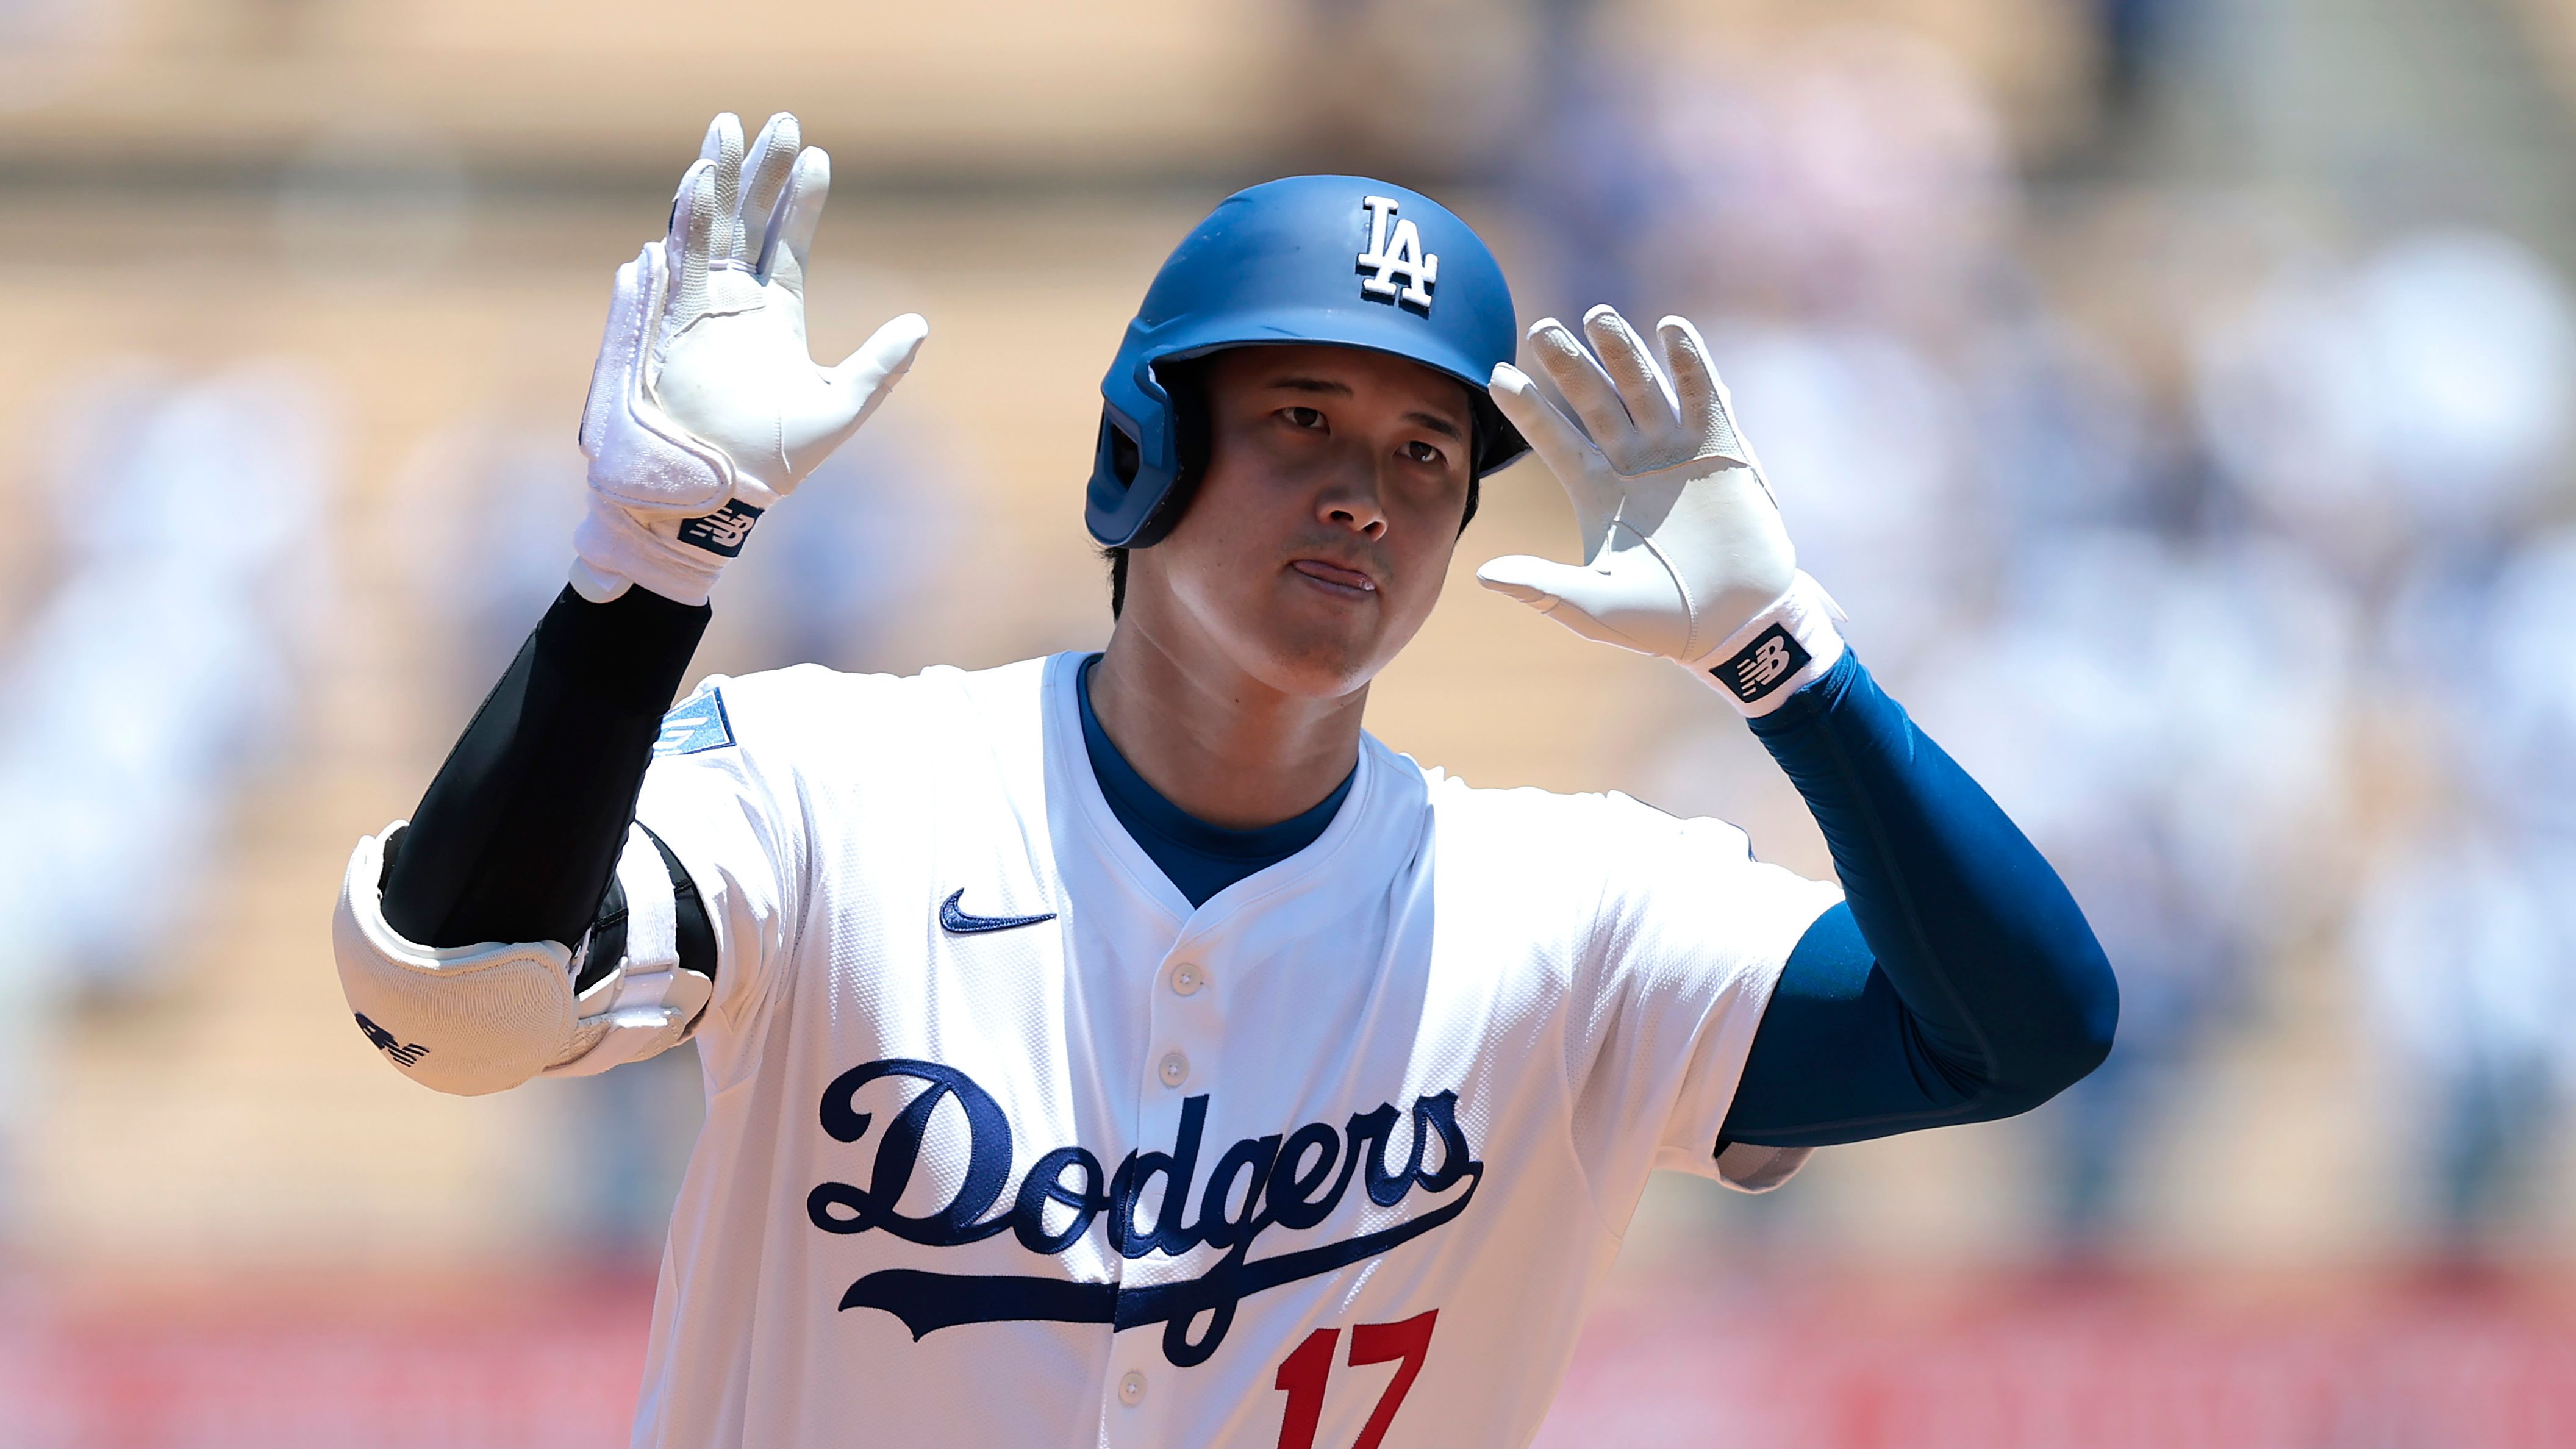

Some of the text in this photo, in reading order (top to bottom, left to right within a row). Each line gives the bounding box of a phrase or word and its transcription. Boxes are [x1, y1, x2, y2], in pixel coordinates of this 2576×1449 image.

[1358, 195, 1438, 306] LA
[807, 1058, 1483, 1367] Dodgers
[1274, 1309, 1439, 1449] 17
